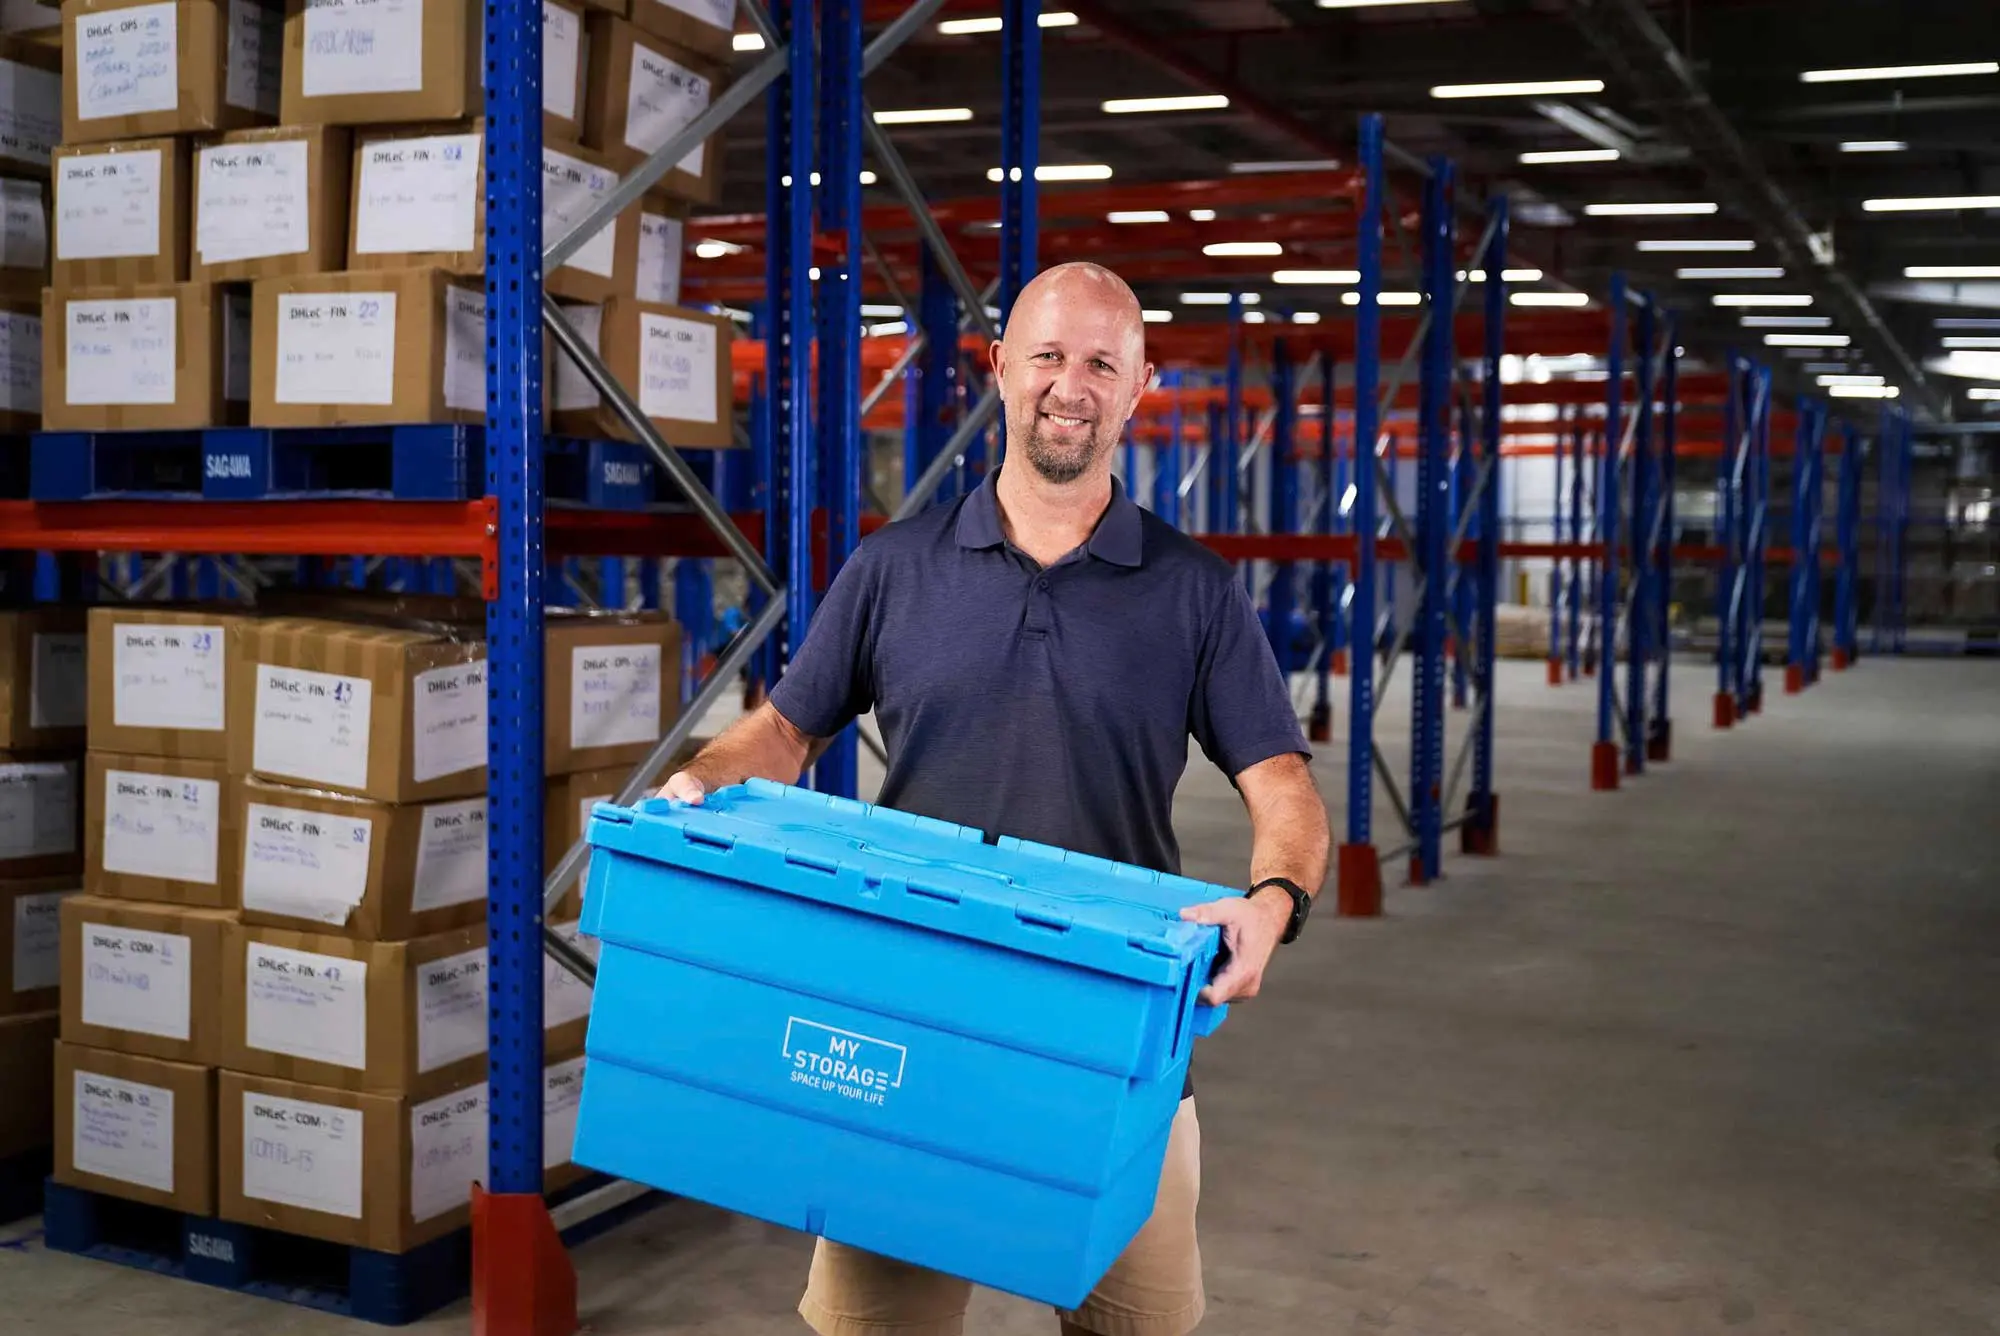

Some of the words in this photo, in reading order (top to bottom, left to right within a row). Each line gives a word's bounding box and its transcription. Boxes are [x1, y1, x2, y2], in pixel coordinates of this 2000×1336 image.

[373, 150, 404, 164] DHLeC
[413, 149, 430, 162] FIN
[566, 168, 582, 184] FIN
[114, 311, 130, 323] FIN
[290, 306, 321, 320] DHLeC
[330, 305, 347, 319] FIN
[206, 453, 251, 478] SAGAWA
[126, 634, 156, 648] DHLeC
[164, 635, 180, 649] FIN
[269, 677, 300, 694] DHLeC
[308, 683, 325, 697] FIN
[428, 676, 459, 694] DHLeC
[466, 672, 482, 687] FIN
[117, 781, 148, 797] DHLeC
[156, 786, 173, 799] FIN
[260, 816, 295, 834] DHLeC
[302, 821, 321, 837] FIN
[129, 940, 154, 955] COM
[257, 956, 290, 974] DHLeC
[297, 963, 316, 978] FIN
[428, 967, 460, 987] DHLeC
[465, 961, 481, 976] FIN
[829, 1035, 860, 1060] MY
[794, 1050, 889, 1092] STORAGE
[790, 1070, 820, 1088] SPACE
[822, 1079, 836, 1093] UP
[837, 1084, 862, 1100] YOUR
[864, 1092, 885, 1107] LIFE
[253, 1104, 287, 1122] DHLeC
[295, 1111, 321, 1128] COM
[420, 1105, 452, 1128] DHLeC
[456, 1097, 479, 1114] COM
